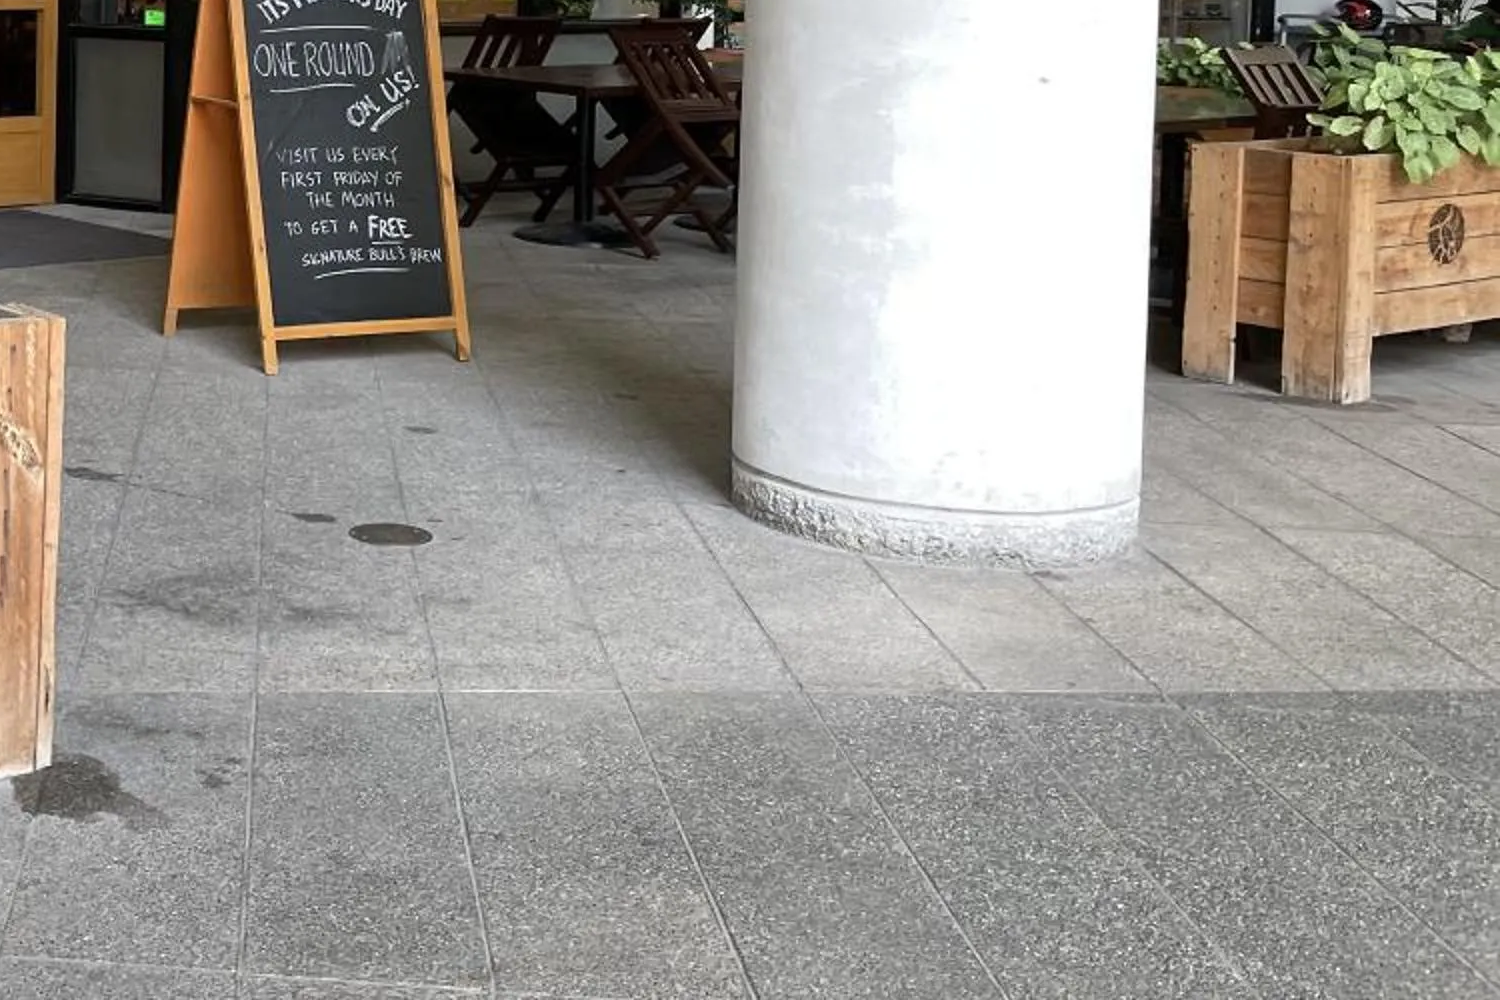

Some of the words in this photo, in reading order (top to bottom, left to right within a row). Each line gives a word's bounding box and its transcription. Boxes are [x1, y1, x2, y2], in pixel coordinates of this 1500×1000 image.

[253, 41, 301, 77] ONE
[303, 41, 375, 77] ROUND
[346, 94, 381, 127] ON
[276, 147, 318, 165] VISIT
[325, 147, 346, 164] US
[353, 145, 399, 165] EVERY
[280, 171, 323, 189] FIRST
[333, 171, 379, 187] FRIDAY
[385, 171, 403, 187] OF
[305, 191, 335, 209] THE
[341, 191, 395, 208] MONTH
[284, 221, 303, 237] TO
[311, 219, 338, 235] GET
[348, 220, 359, 233] A
[367, 214, 414, 239] FREE
[301, 248, 364, 267] SIGNATURE
[410, 248, 443, 264] BREW
